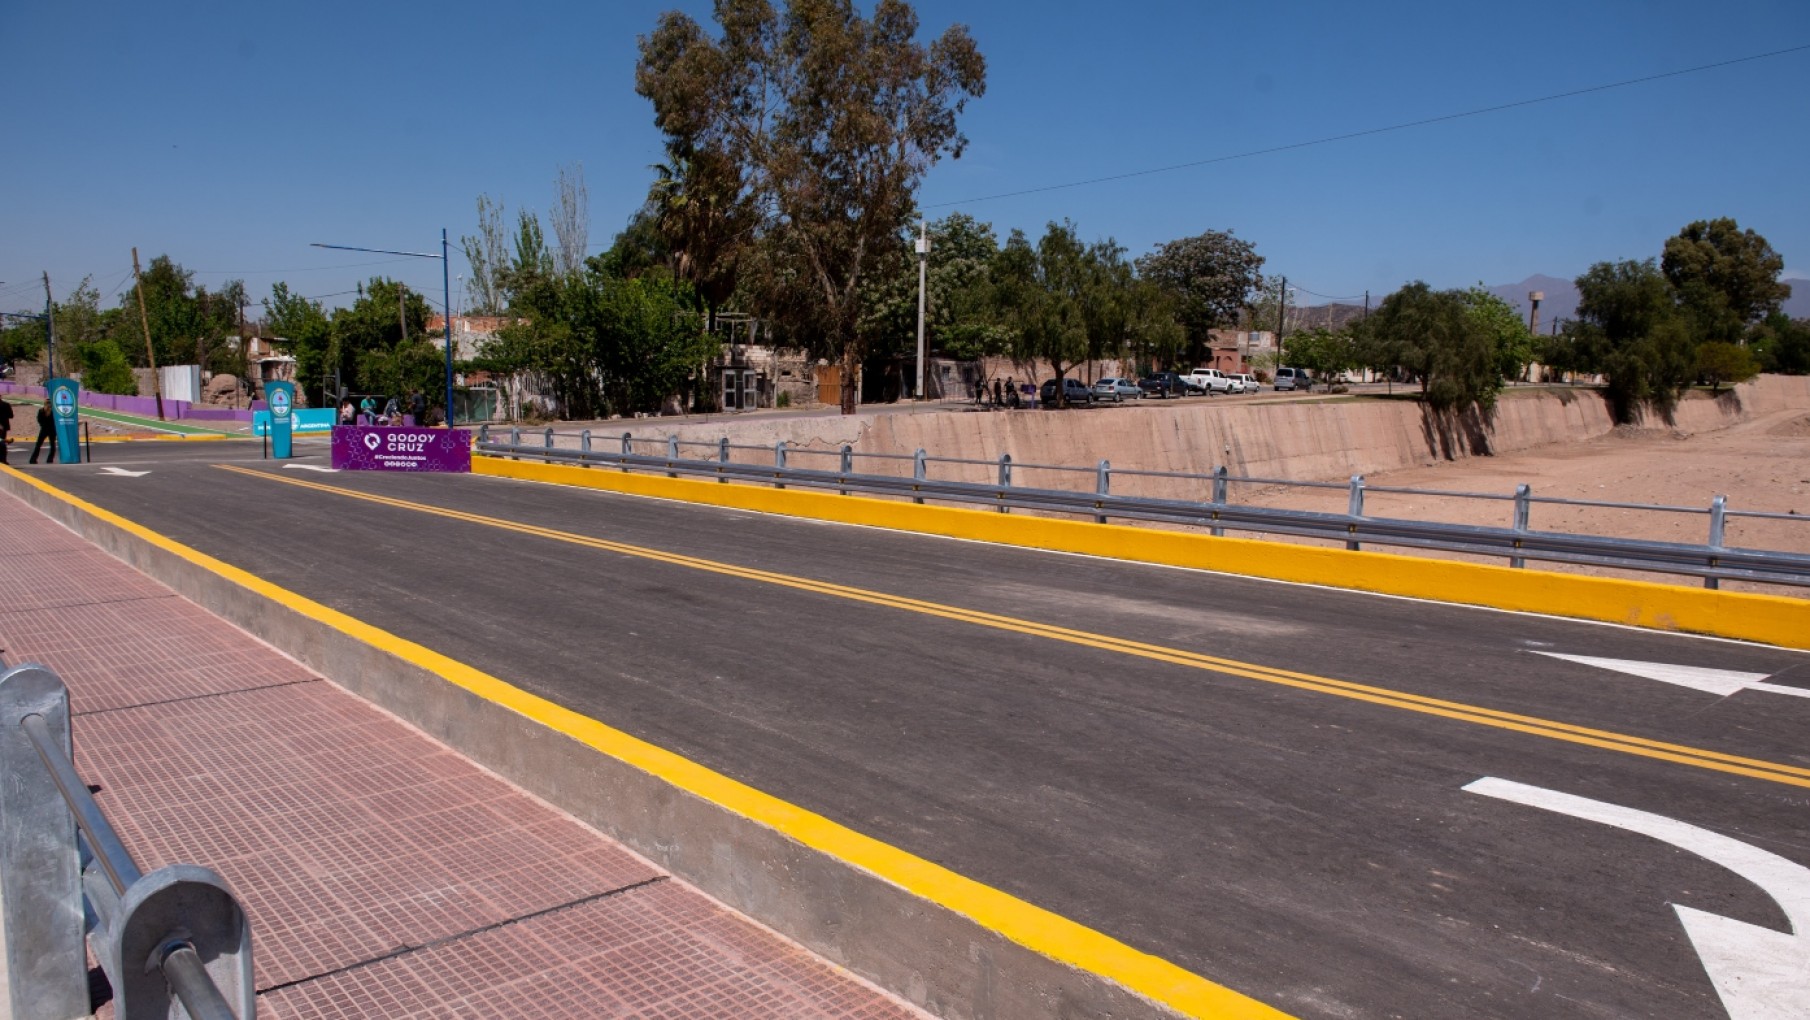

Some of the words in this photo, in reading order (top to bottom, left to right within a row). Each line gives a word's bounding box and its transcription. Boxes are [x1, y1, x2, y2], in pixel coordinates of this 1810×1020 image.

[300, 422, 331, 430] ARGENTINA
[387, 433, 436, 443] GODOY
[387, 442, 424, 452] CRUZ
